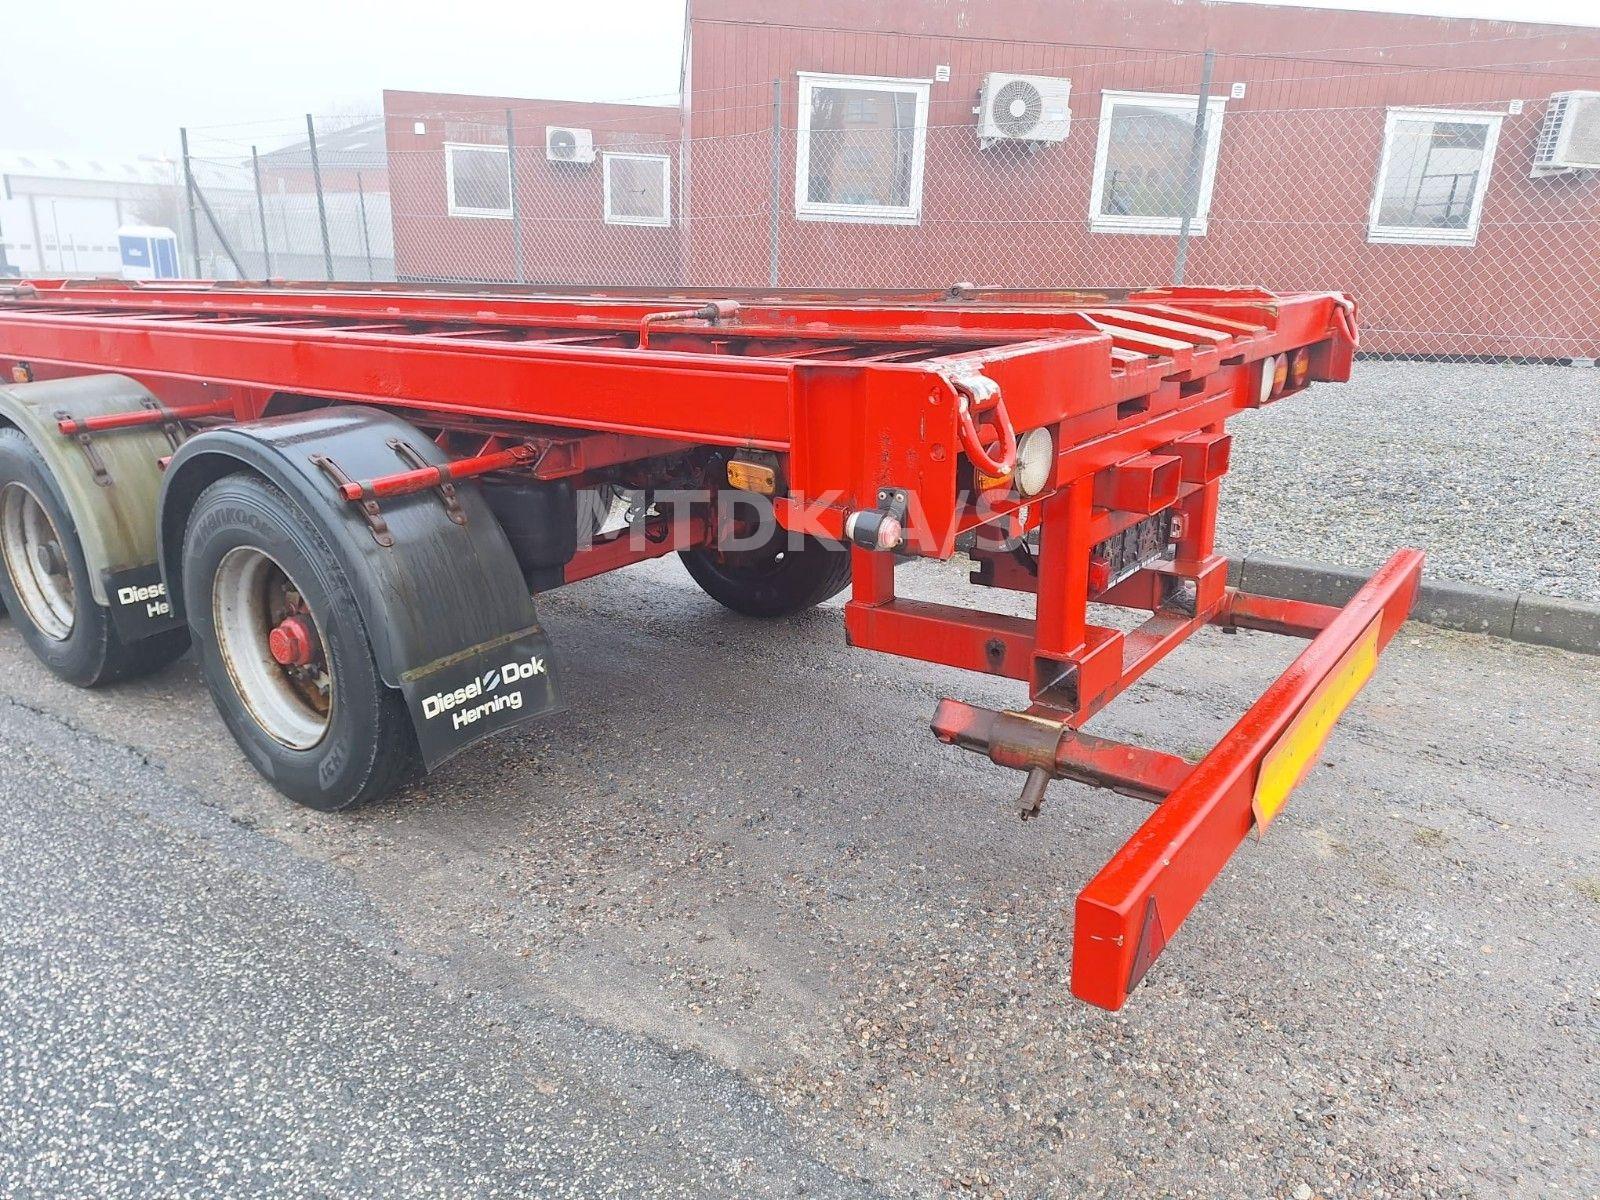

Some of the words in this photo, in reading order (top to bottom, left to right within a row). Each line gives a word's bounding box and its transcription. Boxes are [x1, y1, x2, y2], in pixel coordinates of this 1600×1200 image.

[117, 582, 167, 605] Diese
[421, 676, 482, 720] Diesel
[501, 656, 545, 685] Dok
[452, 690, 523, 731] Herning
